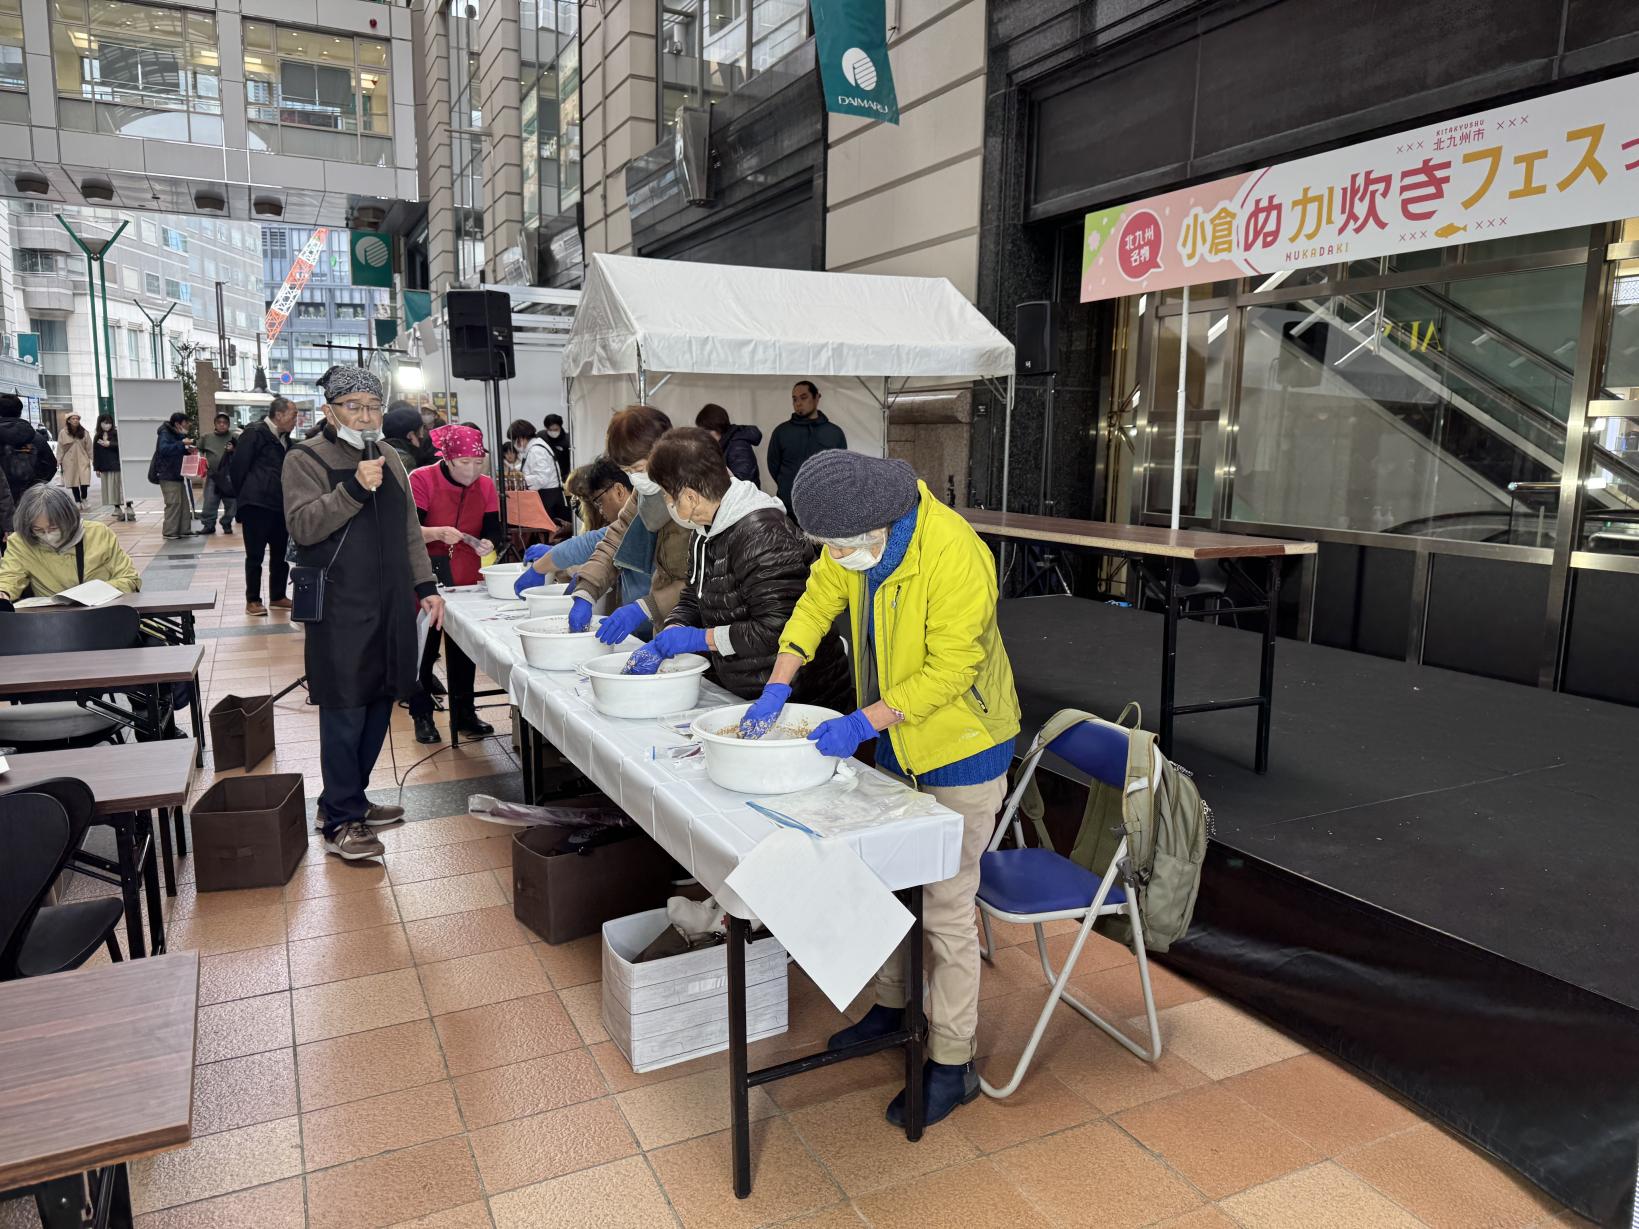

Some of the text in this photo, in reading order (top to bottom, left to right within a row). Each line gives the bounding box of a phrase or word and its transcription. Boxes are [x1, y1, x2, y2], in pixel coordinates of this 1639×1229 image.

[838, 95, 889, 114] DAIMARU
[1436, 119, 1485, 137] KITAKYUSHU
[1433, 128, 1485, 151] 北九州市
[1124, 224, 1155, 250] 北九州
[1130, 247, 1150, 267] 名物
[1285, 241, 1349, 262] NUKADAKI
